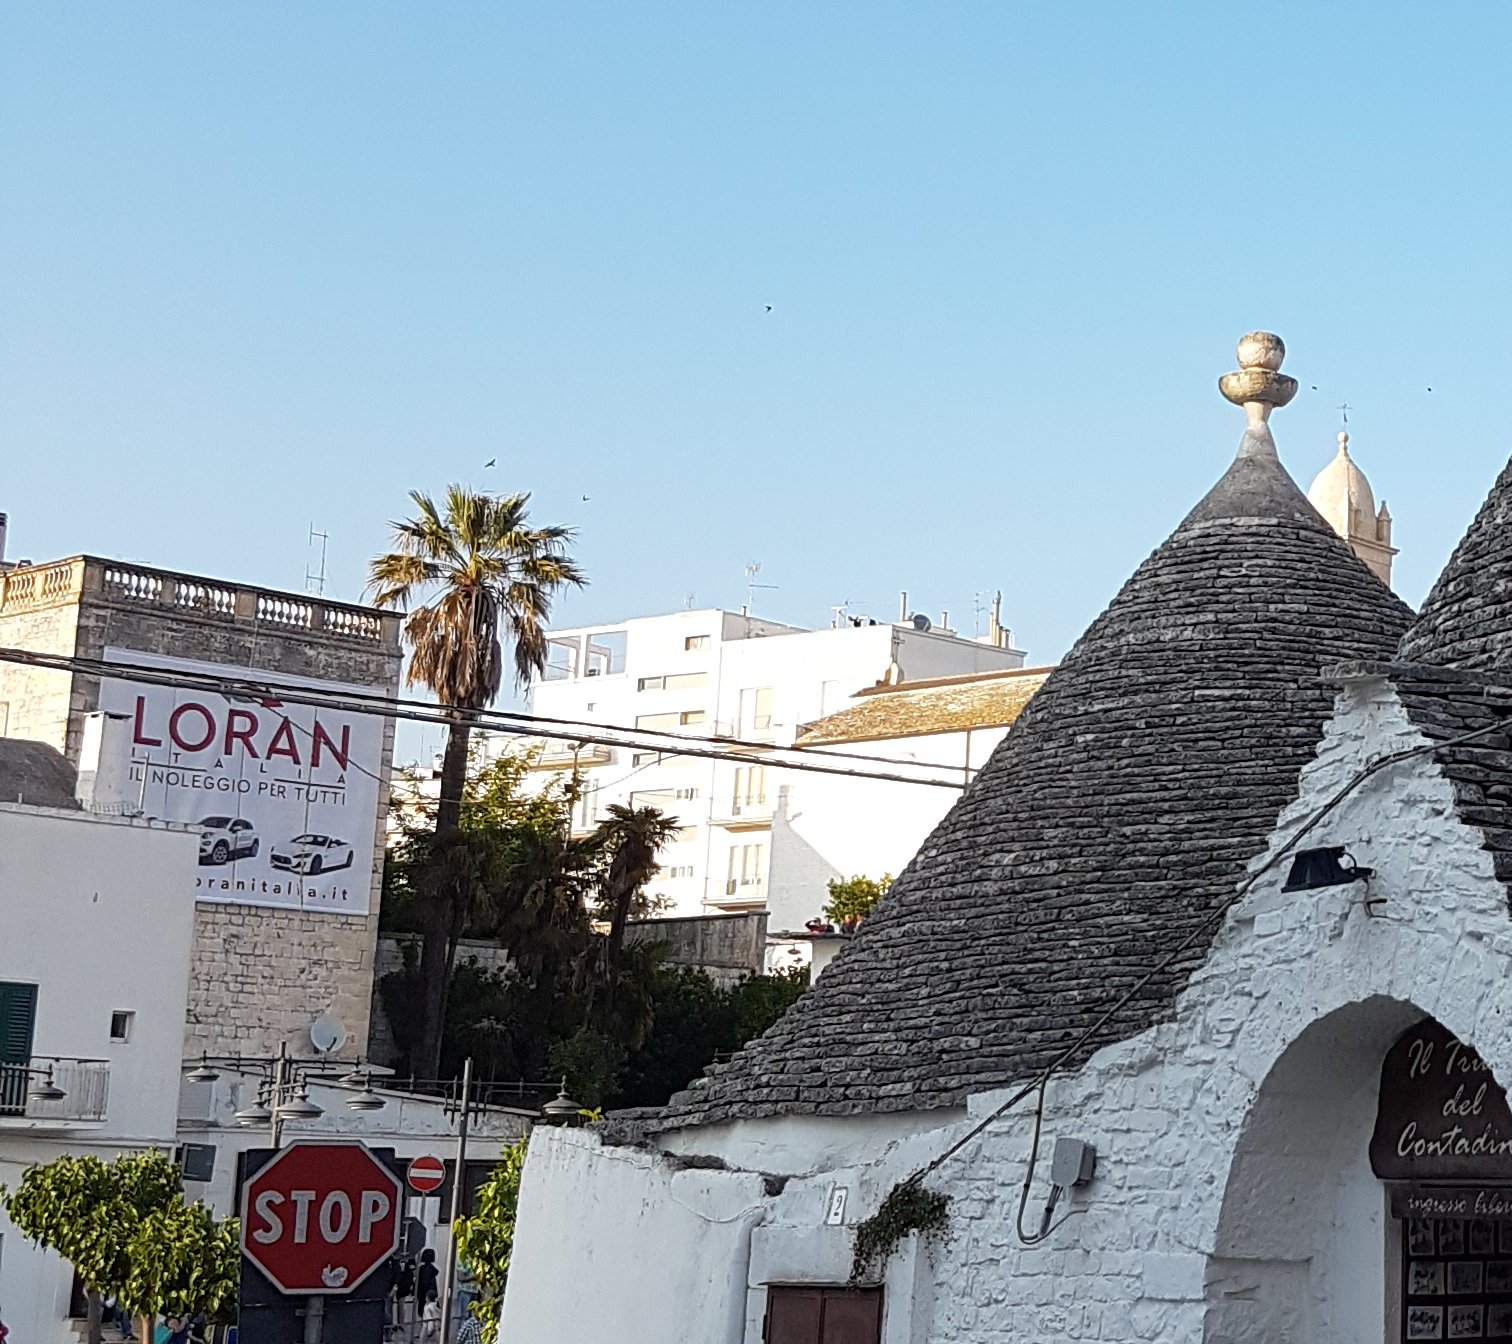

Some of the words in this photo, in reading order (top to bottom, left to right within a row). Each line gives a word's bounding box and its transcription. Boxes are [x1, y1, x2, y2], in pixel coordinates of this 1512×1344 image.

[133, 695, 351, 772] LORAN
[131, 746, 346, 785] ITALIA
[129, 766, 143, 782] IL
[152, 769, 251, 794] NOLEGGIO
[258, 781, 286, 800] PER
[295, 787, 346, 807] TUTTI
[1442, 1082, 1487, 1117] del
[252, 1189, 390, 1244] STOP
[1408, 1194, 1466, 1218] ingresso
